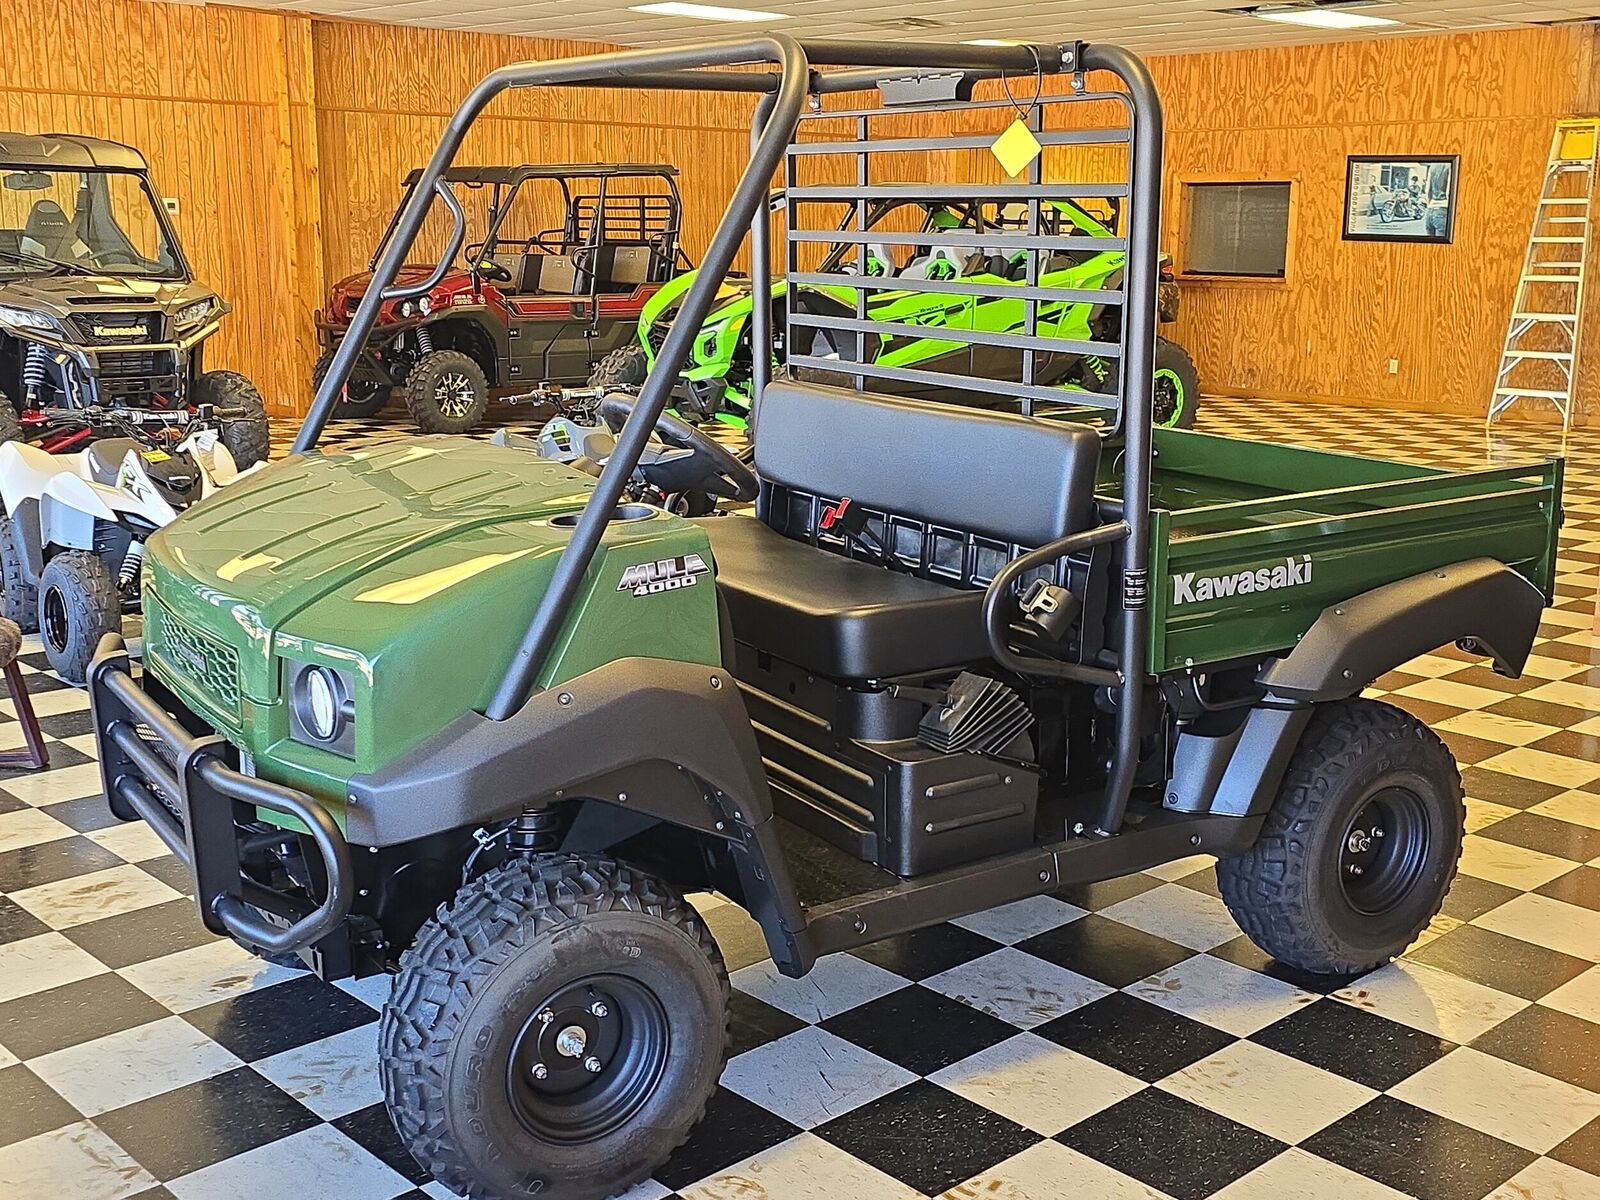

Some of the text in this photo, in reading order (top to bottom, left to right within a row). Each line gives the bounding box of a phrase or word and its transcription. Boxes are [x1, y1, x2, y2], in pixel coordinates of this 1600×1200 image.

[93, 325, 148, 337] Kawasaki
[616, 553, 711, 592] MULE
[633, 575, 697, 597] 4000
[1173, 554, 1313, 605] Kawasaki
